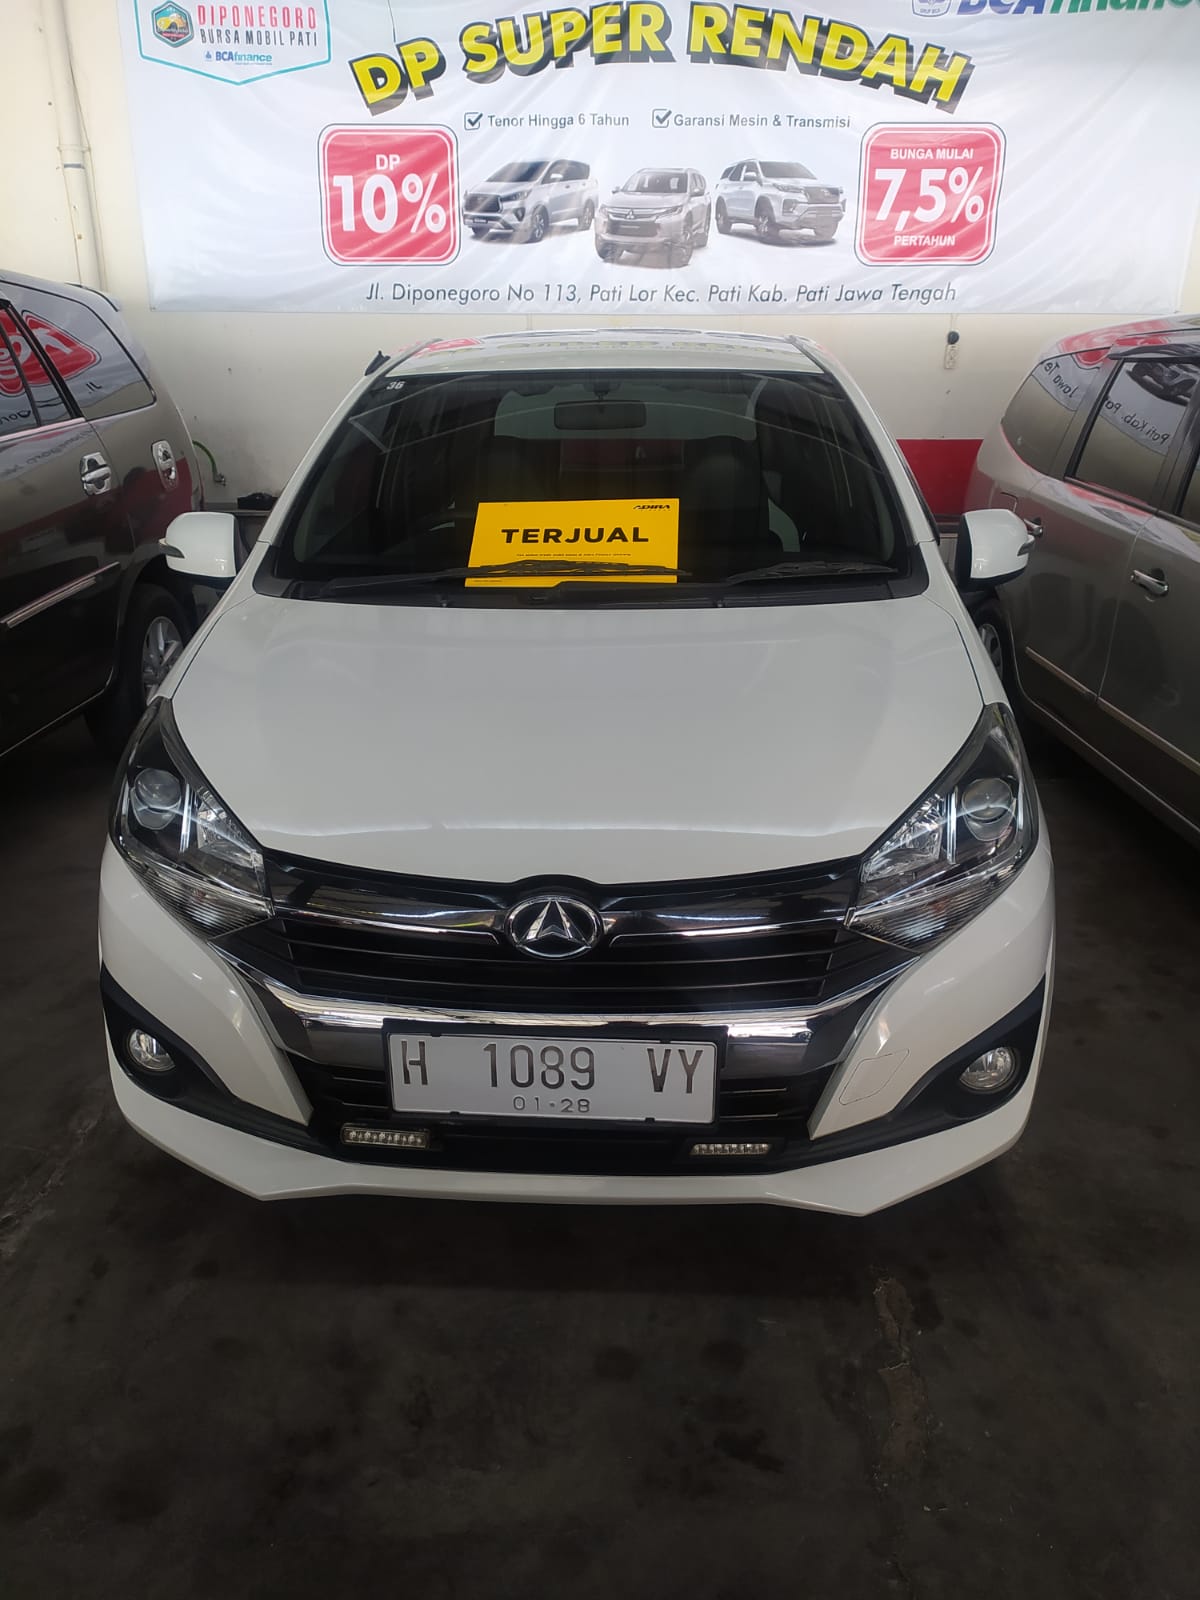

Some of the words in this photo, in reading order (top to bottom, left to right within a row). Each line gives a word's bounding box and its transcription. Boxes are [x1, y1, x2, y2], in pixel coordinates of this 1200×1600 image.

[197, 4, 317, 30] DIPONEGORO
[199, 28, 240, 44] BURSA
[245, 30, 284, 46] MOBIL
[289, 31, 318, 46] PATI
[215, 51, 273, 63] BCAfinance
[348, 36, 447, 116] DP
[459, 1, 677, 84] SUPER
[687, 1, 975, 114] RENDAH
[488, 114, 524, 128] Tenor
[528, 113, 574, 130] Hingga
[578, 112, 586, 125] 6
[590, 113, 630, 126] Tahun
[673, 113, 725, 127] Garansi
[729, 113, 768, 127] Mesin
[772, 114, 782, 127] &
[786, 114, 851, 129] Transmisi
[375, 154, 401, 171] DP
[890, 148, 934, 160] BUNGA
[936, 148, 974, 160] MULAI
[333, 173, 447, 234] 10%
[874, 166, 985, 232] 7,5%
[894, 235, 956, 247] PERTAHUN
[365, 283, 384, 301] Jl.
[392, 283, 500, 306] Diponegoro
[507, 284, 534, 302] No
[544, 284, 582, 304] 113,
[589, 285, 623, 302] Pati
[629, 284, 658, 302] Lor
[663, 285, 701, 303] Kec.
[708, 285, 741, 303] Pati
[748, 285, 788, 302] Kab.
[796, 285, 830, 302] Pati
[835, 285, 883, 302] Jawa
[891, 283, 956, 306] Tengah
[501, 527, 649, 543] TERJUAL
[401, 1040, 428, 1086] H
[482, 1043, 596, 1091] 1089
[646, 1047, 704, 1094] VY
